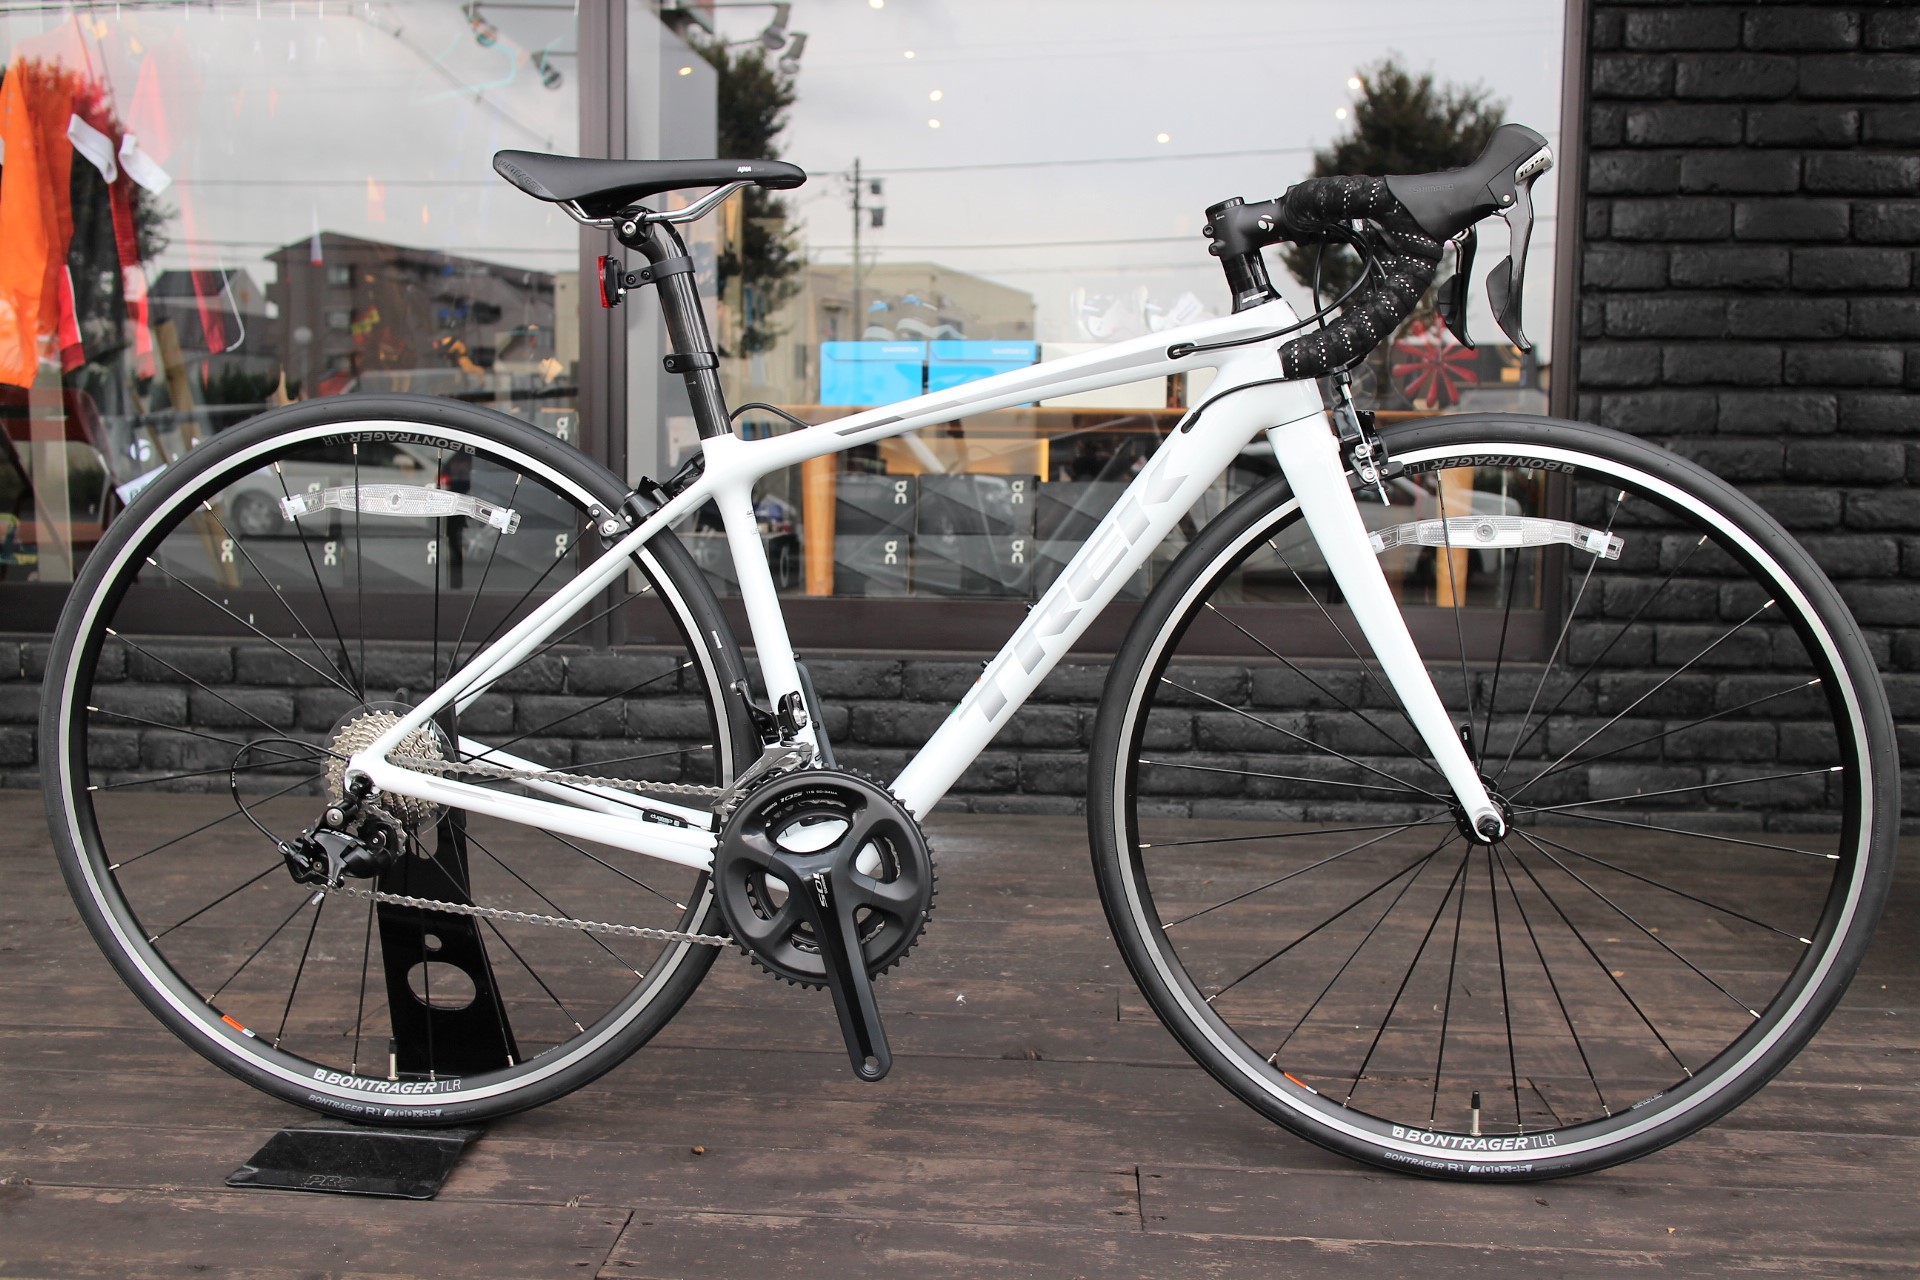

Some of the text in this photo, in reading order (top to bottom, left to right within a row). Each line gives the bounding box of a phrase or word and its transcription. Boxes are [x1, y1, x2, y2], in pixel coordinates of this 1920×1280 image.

[350, 431, 462, 451] BONTRAGER
[1431, 455, 1562, 472] BONTRAGER
[958, 447, 1190, 724] TREK
[325, 1072, 461, 1094] BONTRAGER TLR
[308, 1094, 363, 1113] BONTRAGER
[365, 1106, 381, 1116] R1
[1405, 1129, 1557, 1151] BONTRAGER TLR
[1384, 1152, 1444, 1169] BONTRAGER
[1447, 1163, 1464, 1172] R1
